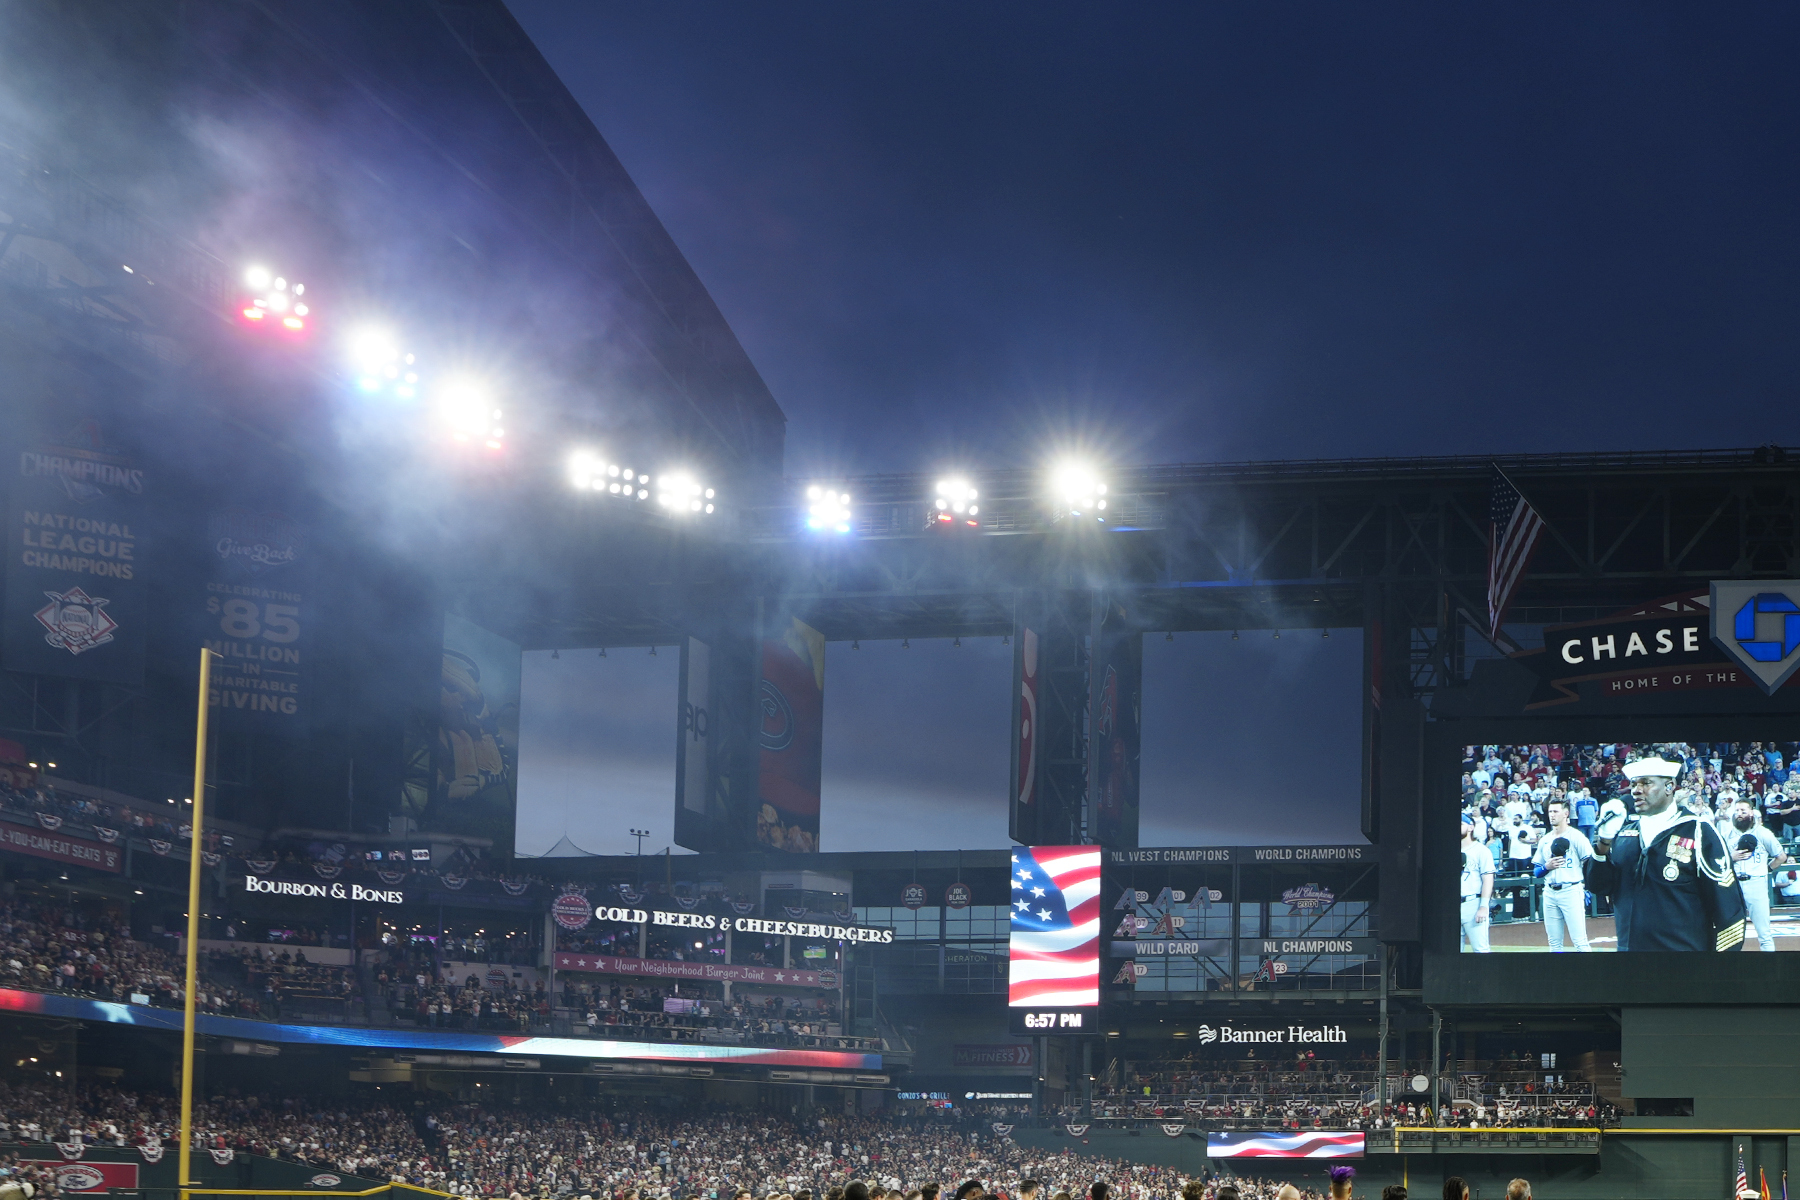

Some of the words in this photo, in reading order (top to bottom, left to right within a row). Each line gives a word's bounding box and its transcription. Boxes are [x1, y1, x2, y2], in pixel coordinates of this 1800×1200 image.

[23, 511, 135, 540] NATIONAL
[22, 528, 134, 561] LEAGUE
[22, 551, 134, 581] CHAMPIONS
[206, 582, 301, 602] CELEBRATING
[1561, 626, 1700, 665] CHASE
[243, 662, 261, 675] IN
[1612, 676, 1659, 691] HOME
[1672, 673, 1692, 686] OF
[1706, 672, 1737, 684] THE
[71, 846, 101, 862] SEATS
[1112, 851, 1125, 862] NL
[1128, 850, 1162, 862] WEST
[1164, 849, 1230, 861] CHAMPIONS
[1255, 849, 1293, 860] WORLD
[1294, 848, 1362, 859] CHAMPIONS
[245, 875, 327, 898] BOURBON
[330, 882, 347, 899] &
[351, 884, 403, 904] BONES
[1210, 891, 1220, 900] 02
[595, 906, 648, 923] COLD
[652, 911, 716, 929] BEERS
[719, 918, 732, 931] &
[735, 917, 894, 944] CHEESEBURGERS
[1136, 943, 1166, 955] WILD
[1168, 942, 1199, 954] CARD
[1264, 941, 1278, 953] NL
[1282, 940, 1353, 953] CHAMPIONS
[614, 958, 638, 974] Your
[641, 960, 703, 978] Neighborhood
[706, 965, 739, 980] Burger
[741, 967, 765, 981] Joint
[1275, 963, 1286, 973] 23
[1025, 1013, 1056, 1028] 6:57
[1060, 1013, 1082, 1028] PM
[1220, 1025, 1286, 1043] Banner
[1288, 1025, 1348, 1043] Health
[972, 1053, 1015, 1062] FITNESS
[897, 1092, 921, 1100] GONZO'S
[930, 1092, 947, 1100] GRILL
